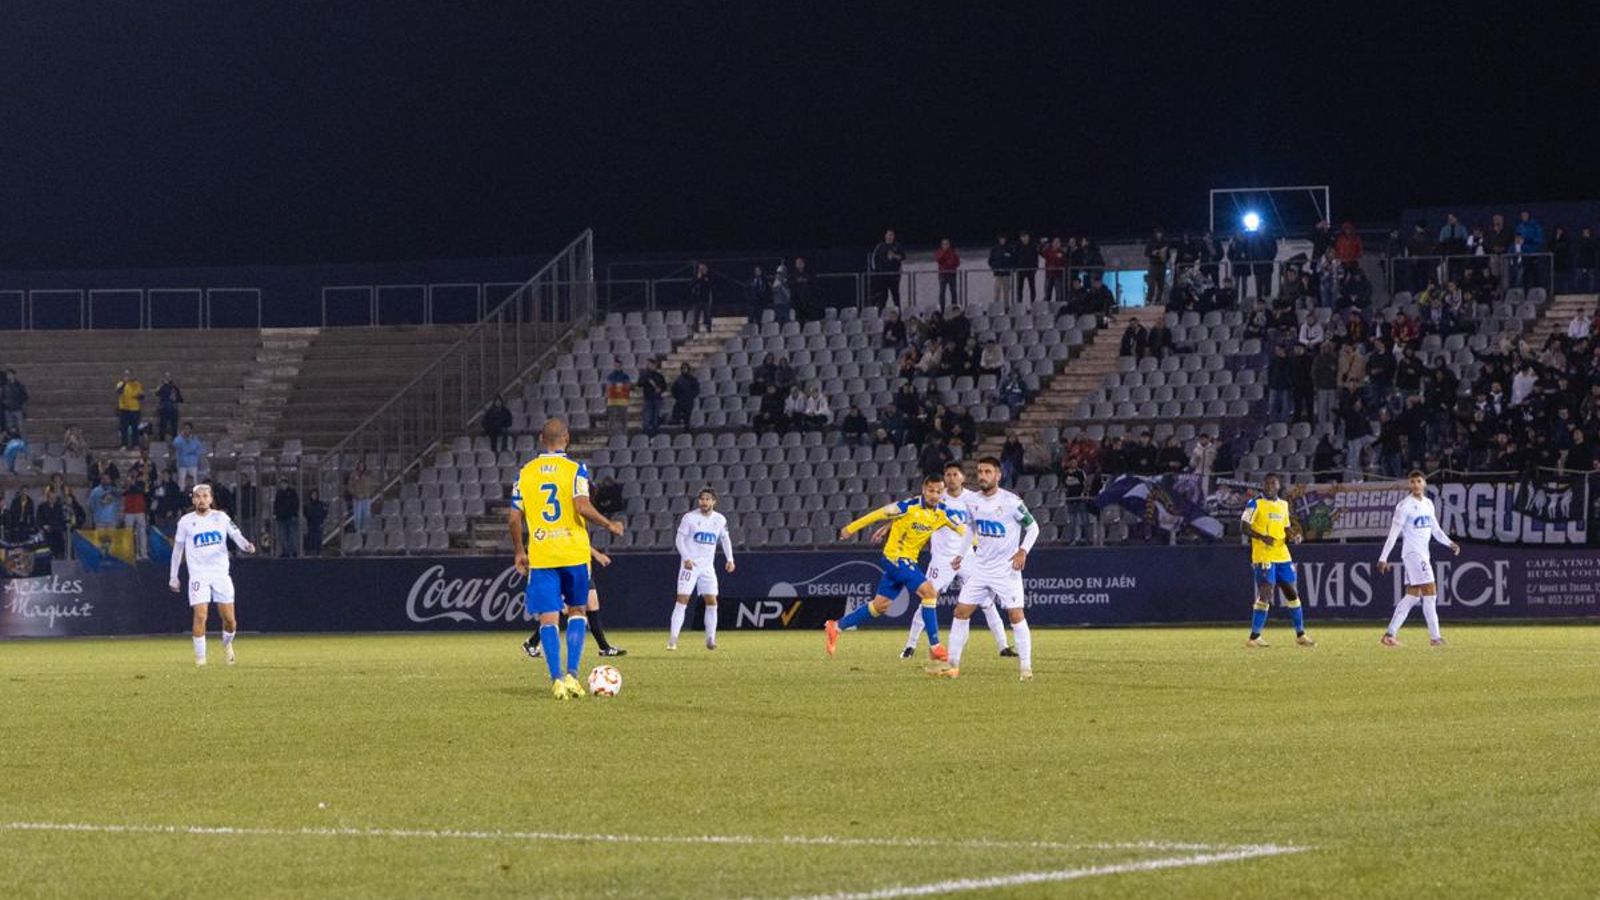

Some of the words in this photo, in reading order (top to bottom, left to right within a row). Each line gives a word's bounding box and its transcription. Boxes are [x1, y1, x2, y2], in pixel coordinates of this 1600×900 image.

[540, 483, 562, 522] 3
[4, 574, 83, 596] Aceites
[929, 567, 938, 579] 16
[1023, 577, 1083, 589] TORIZADO
[1086, 577, 1102, 588] EN
[1105, 573, 1136, 588] JAÉN
[1388, 560, 1510, 607] TECE
[406, 564, 540, 622] Coca-Co
[808, 583, 872, 595] DESGUACE
[4, 598, 94, 628] Maquiz
